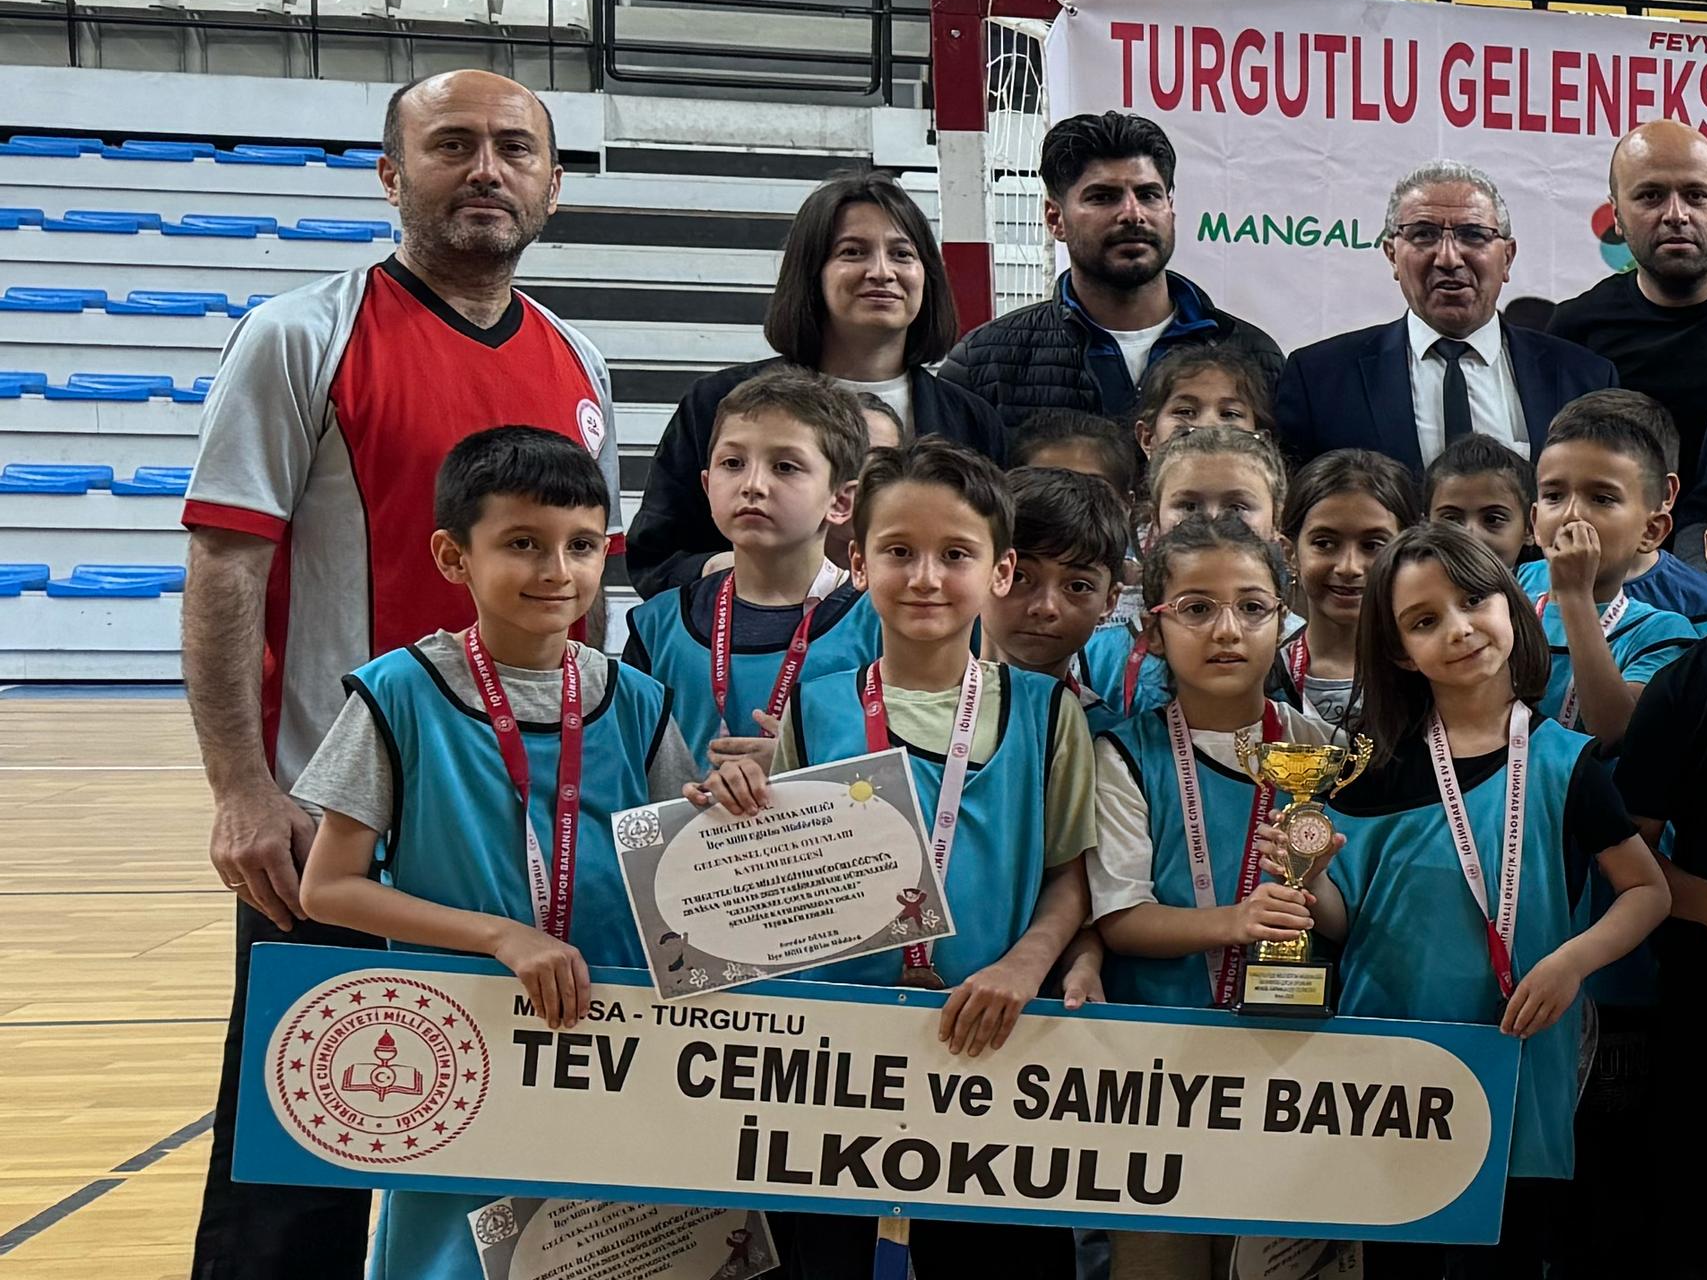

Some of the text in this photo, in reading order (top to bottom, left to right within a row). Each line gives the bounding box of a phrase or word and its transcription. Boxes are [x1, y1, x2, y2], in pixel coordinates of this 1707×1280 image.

[1111, 22, 1419, 124] TURGUTLU
[558, 868, 569, 901] SPOR
[383, 1011, 424, 1031] MİLLİ
[513, 995, 626, 1023] MSA
[651, 1004, 805, 1036] TURGUTLU
[513, 1029, 1455, 1141] TEV CEMİLE ve SAMİYE BAYAR
[736, 1115, 1183, 1206] İLKOKULU
